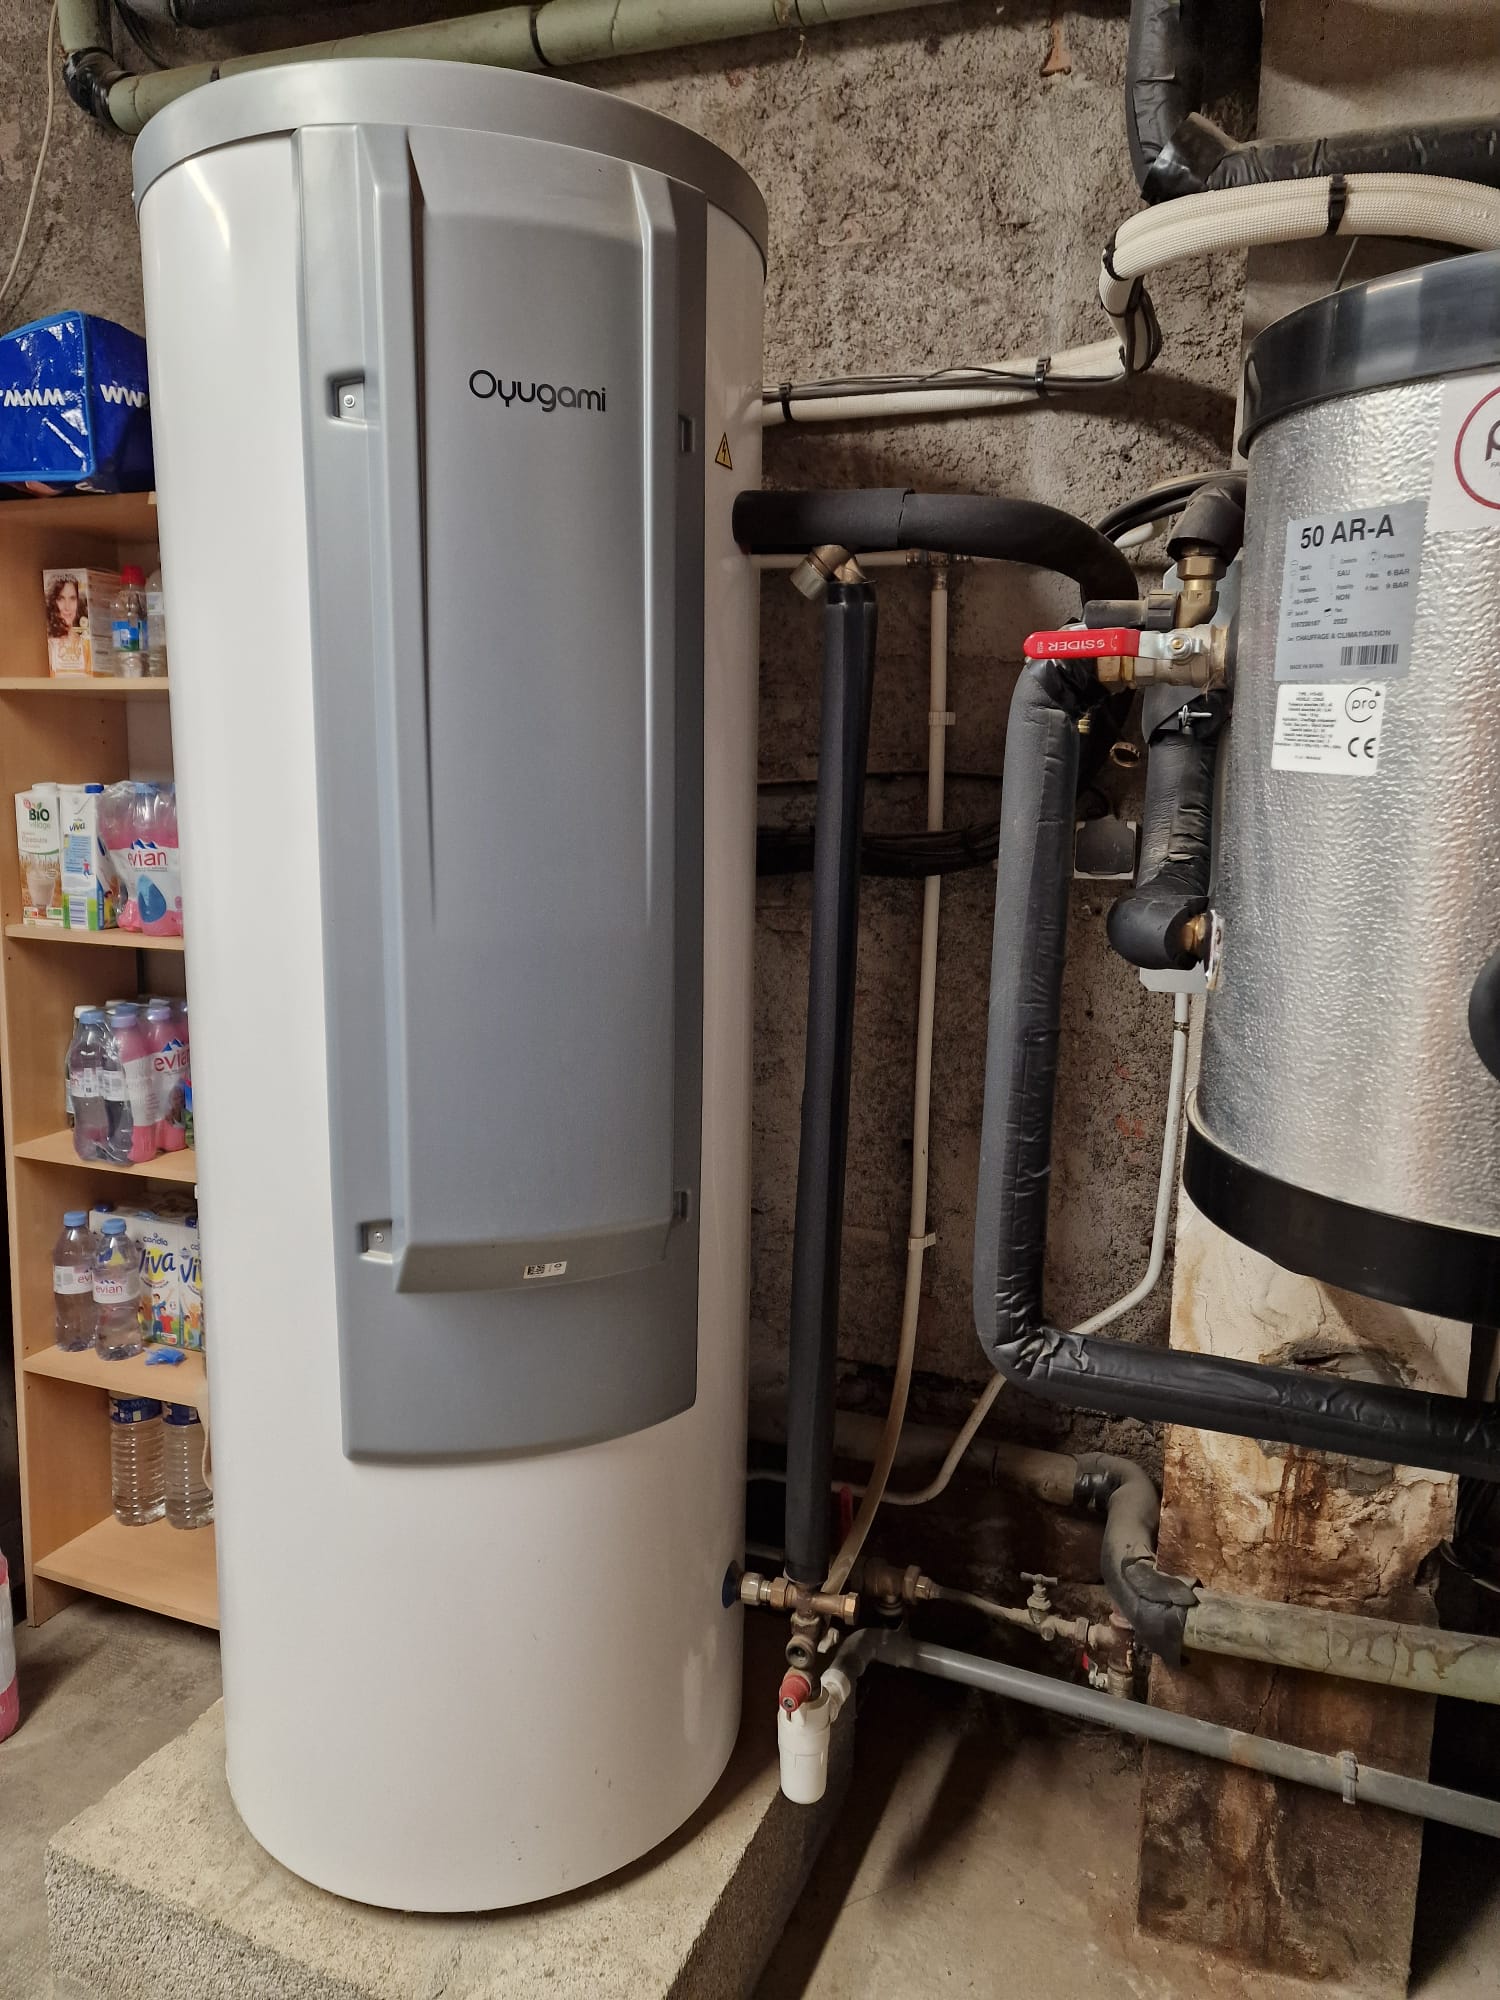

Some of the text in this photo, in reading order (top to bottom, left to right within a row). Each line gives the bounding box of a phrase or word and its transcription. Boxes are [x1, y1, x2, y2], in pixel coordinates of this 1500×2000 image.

[469, 369, 606, 412] Oyugami
[1300, 514, 1395, 549] 50 AR-A
[1393, 568, 1410, 576] BAR
[1392, 581, 1409, 589] BAR
[1351, 699, 1377, 711] pro
[1347, 736, 1377, 759] CE
[77, 1272, 93, 1284] evi
[180, 1257, 202, 1283] Vi
